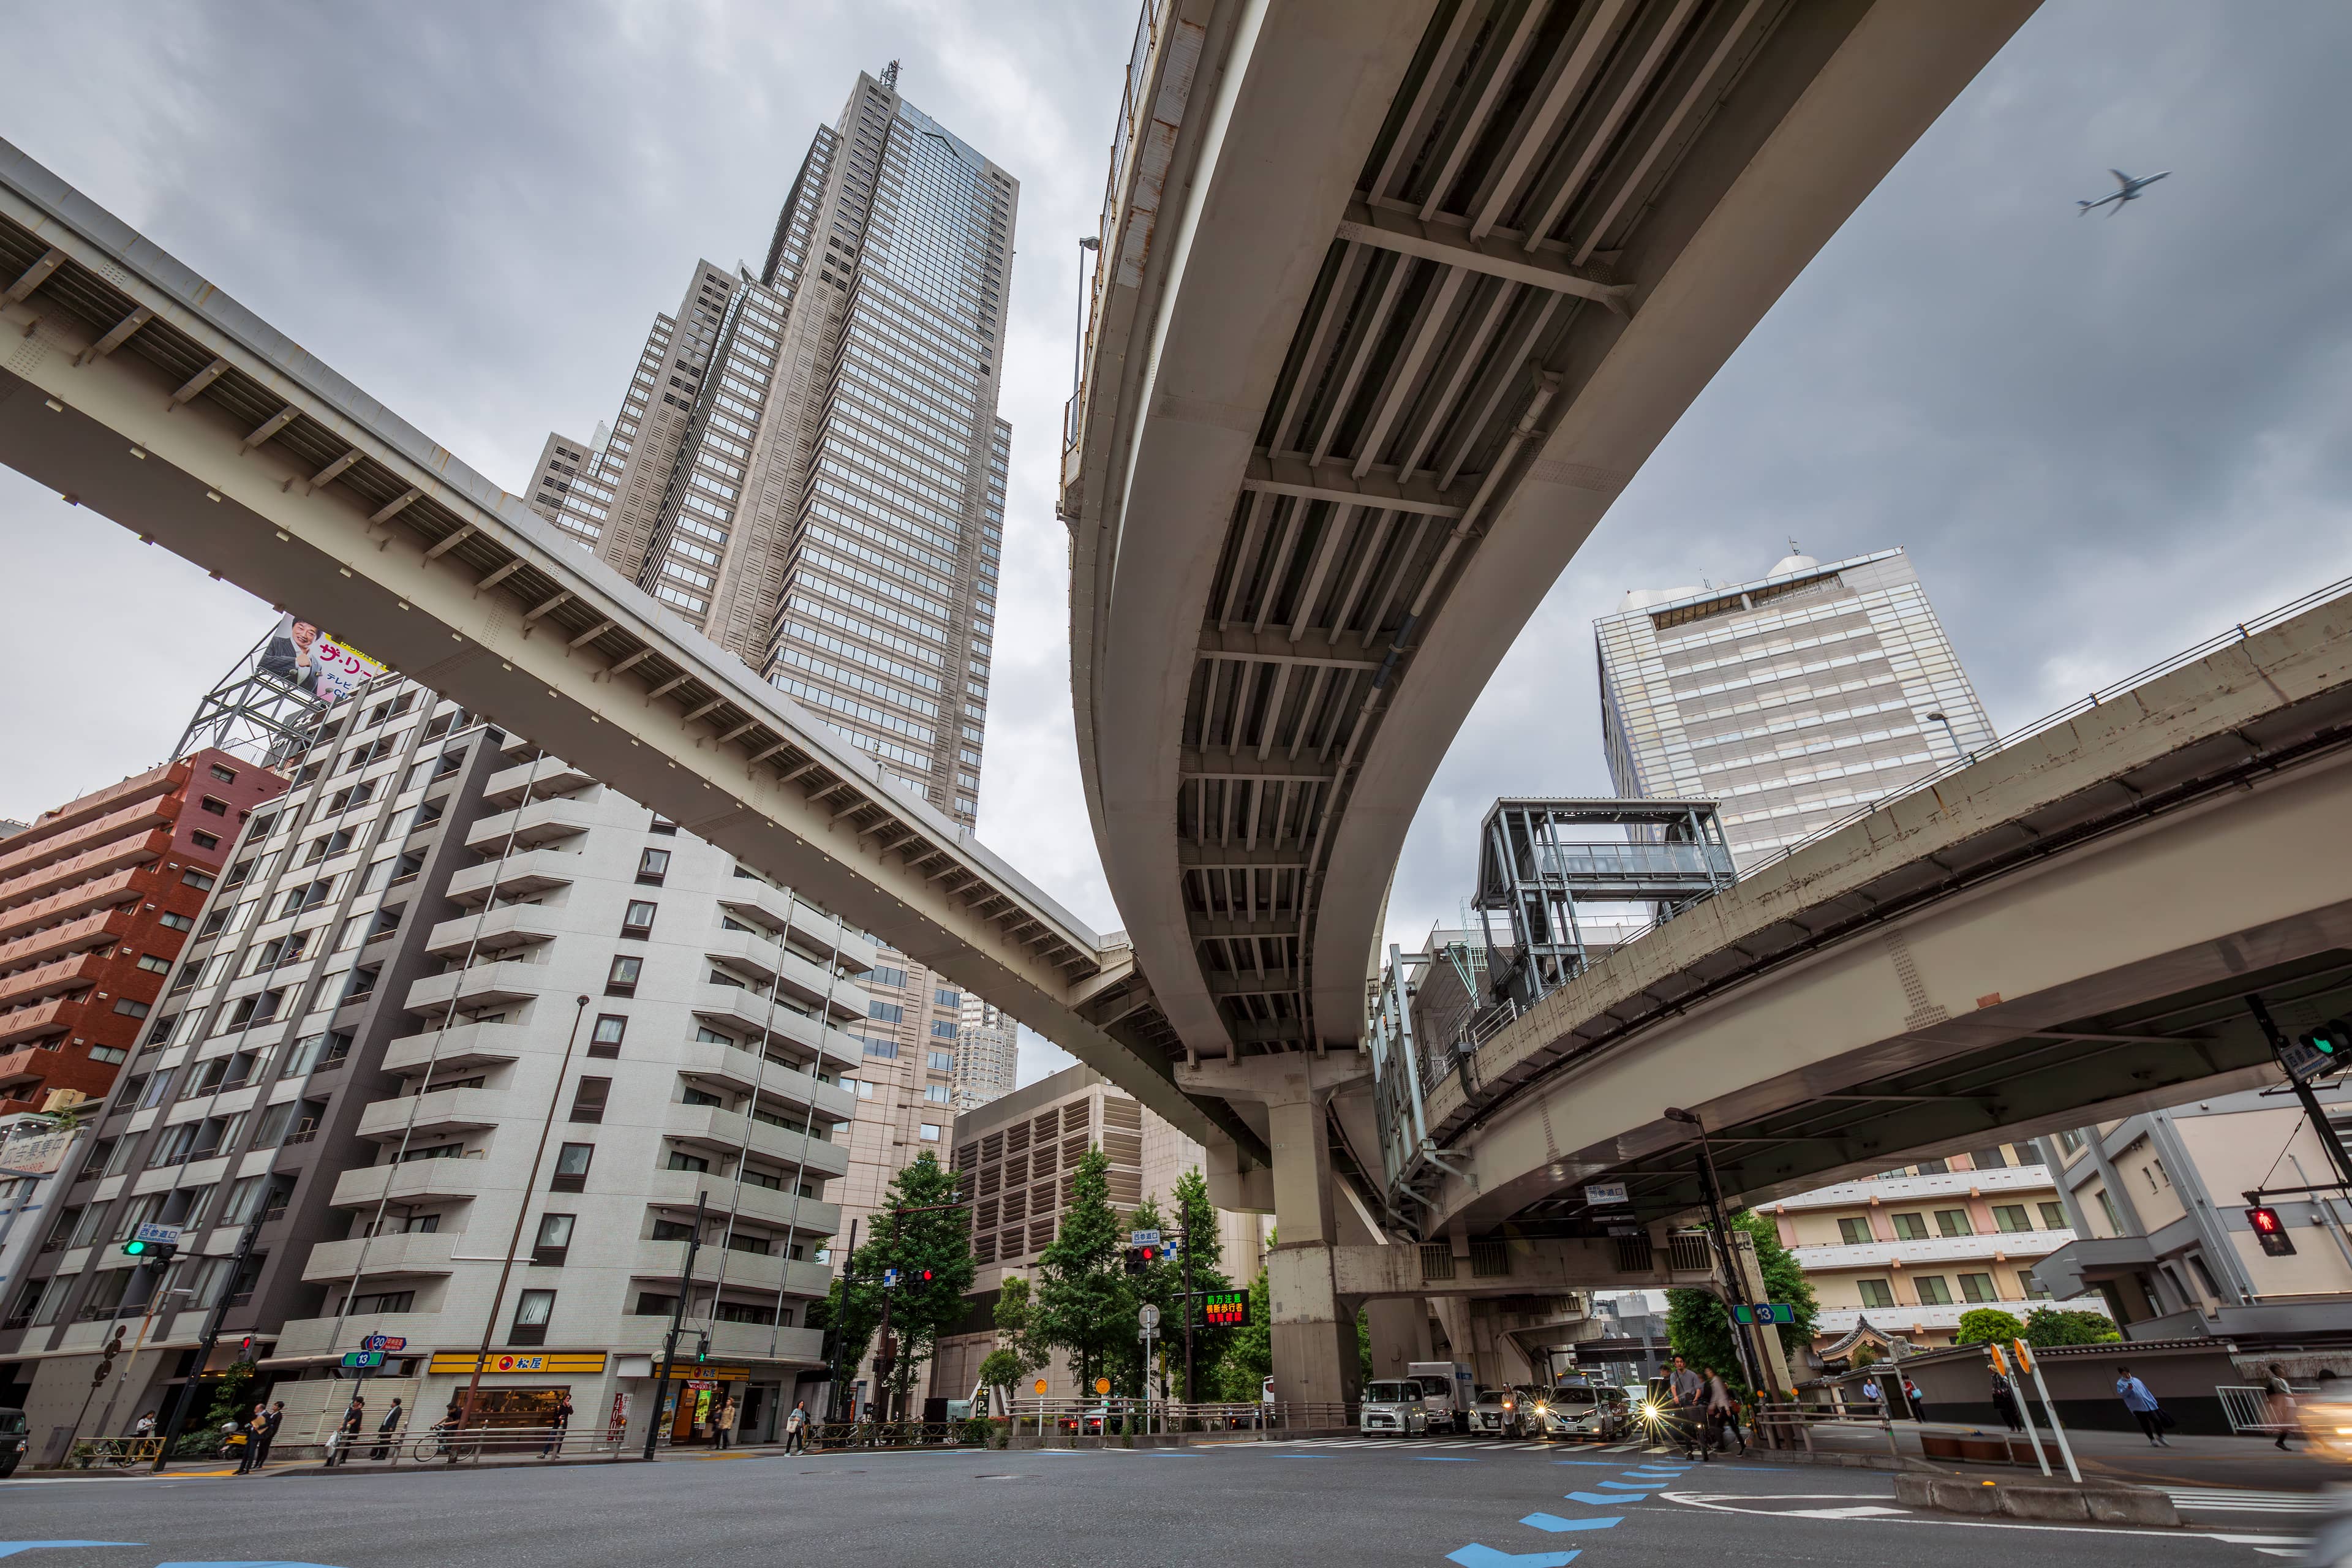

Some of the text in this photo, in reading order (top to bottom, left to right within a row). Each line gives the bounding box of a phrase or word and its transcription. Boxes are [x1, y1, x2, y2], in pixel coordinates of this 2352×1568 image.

[320, 644, 378, 678] ザ・リー
[1588, 1188, 1623, 1199] 西参道口
[140, 1227, 178, 1238] 西参道口
[1207, 1293, 1241, 1305] 前方注意
[1206, 1303, 1243, 1314] 横断歩行者
[1756, 1308, 1771, 1320] 13
[1208, 1312, 1242, 1323] 有無確認
[374, 1337, 385, 1346] 20
[358, 1354, 368, 1363] 13
[516, 1357, 543, 1369] 松屋
[978, 1401, 985, 1411] P
